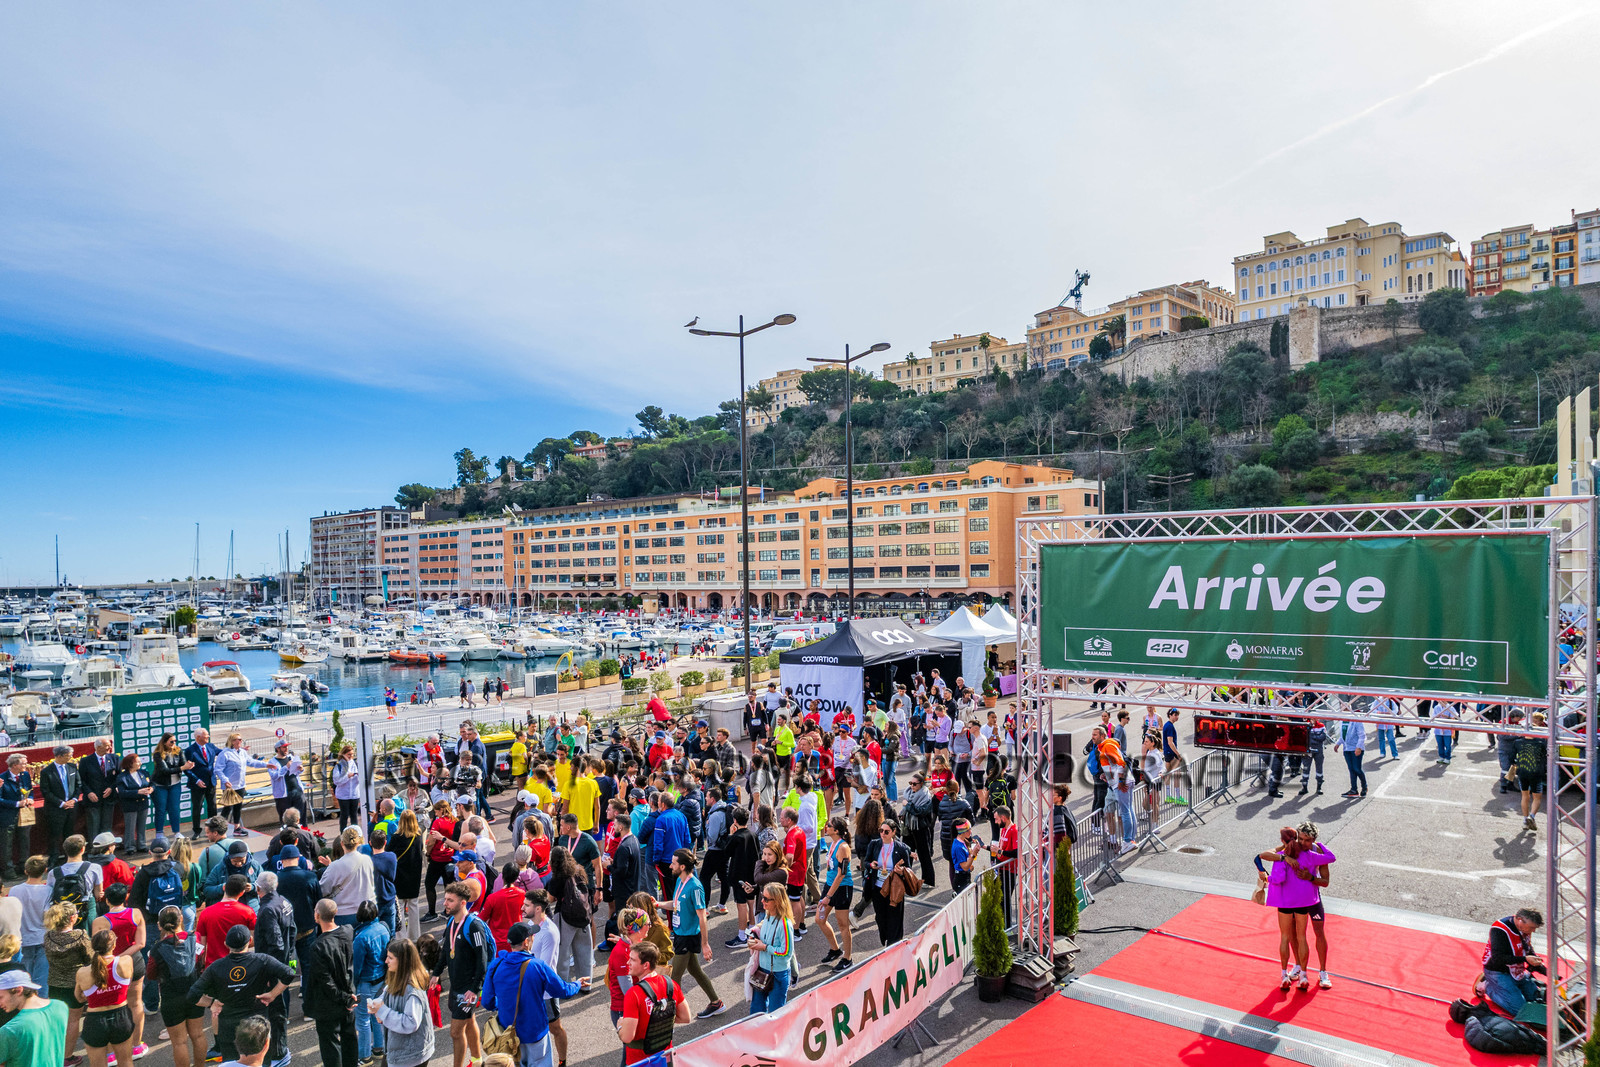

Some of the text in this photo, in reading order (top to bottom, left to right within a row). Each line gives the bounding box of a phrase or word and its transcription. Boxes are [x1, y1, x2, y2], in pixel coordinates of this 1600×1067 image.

[1149, 560, 1386, 613] Arrivée
[1149, 643, 1184, 654] 42K
[1246, 645, 1304, 657] MONAFRAIS
[1423, 650, 1478, 668] Carlo
[795, 683, 821, 697] ACT
[96, 984, 122, 995] MALTA
